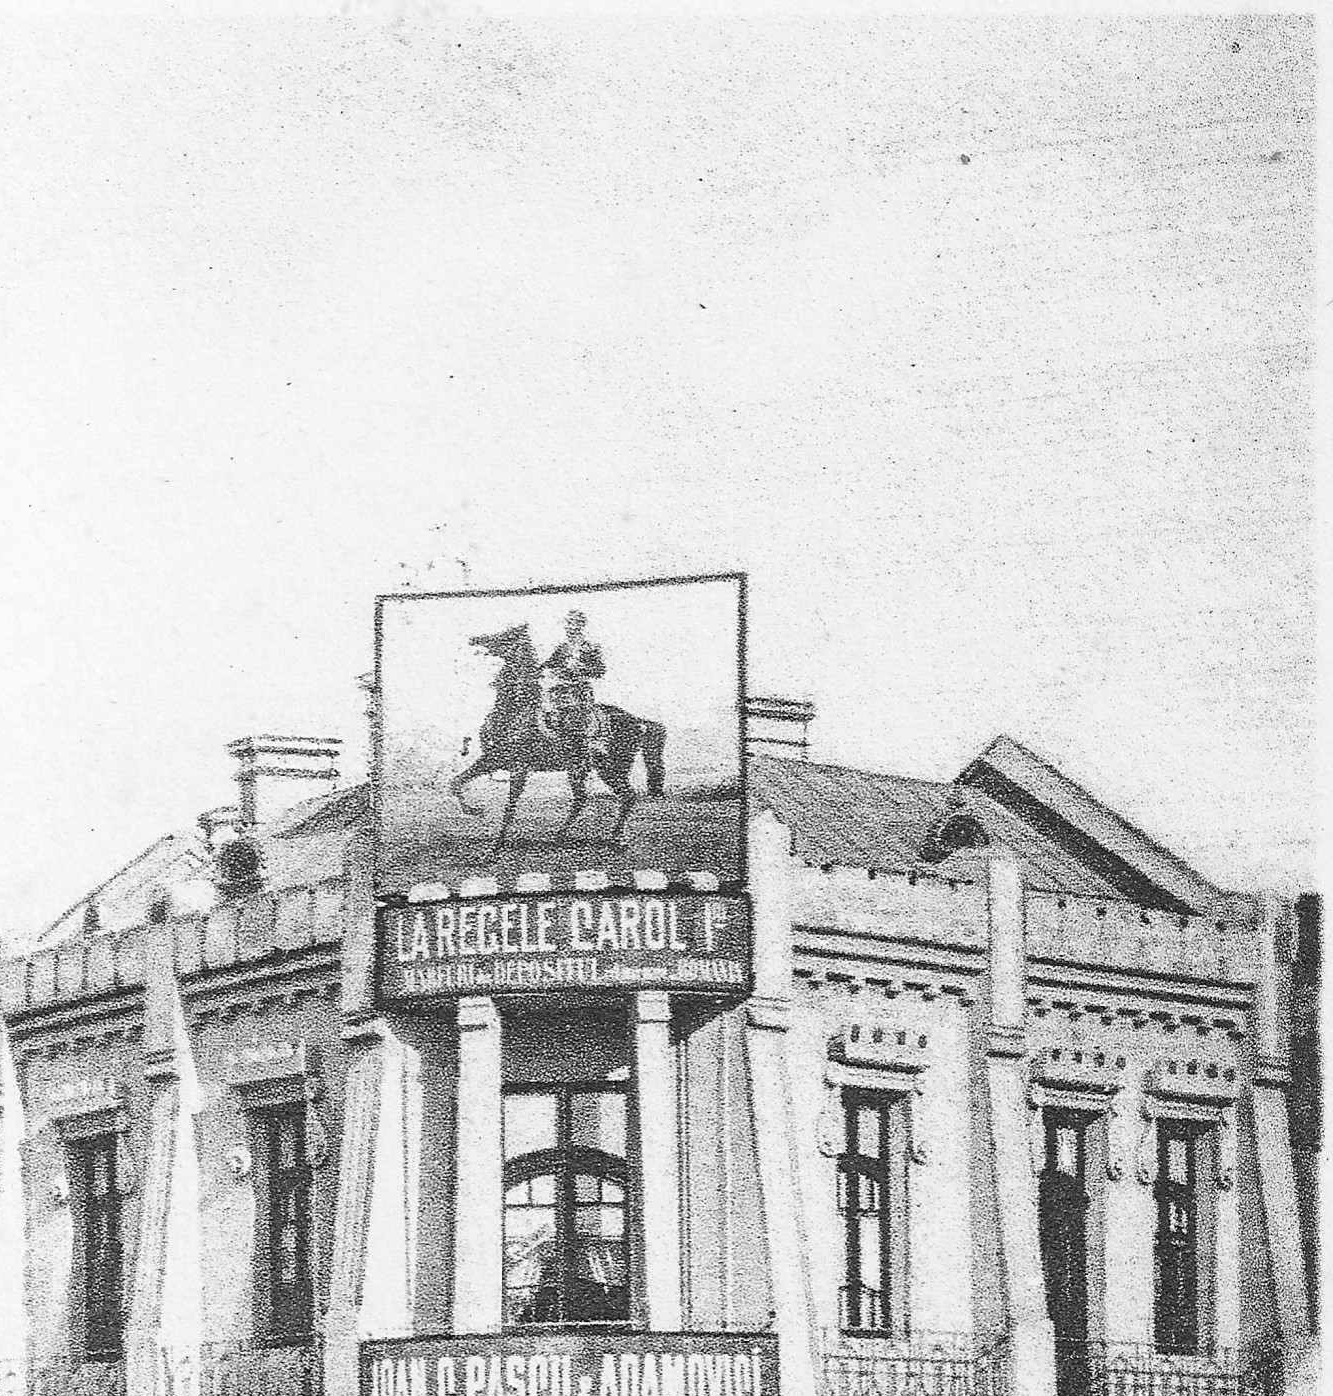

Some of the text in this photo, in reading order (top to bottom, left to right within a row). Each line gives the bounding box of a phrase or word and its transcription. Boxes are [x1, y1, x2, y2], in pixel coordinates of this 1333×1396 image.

[396, 910, 430, 962] LA
[435, 902, 557, 957] REGELE
[568, 899, 687, 952] CAROL
